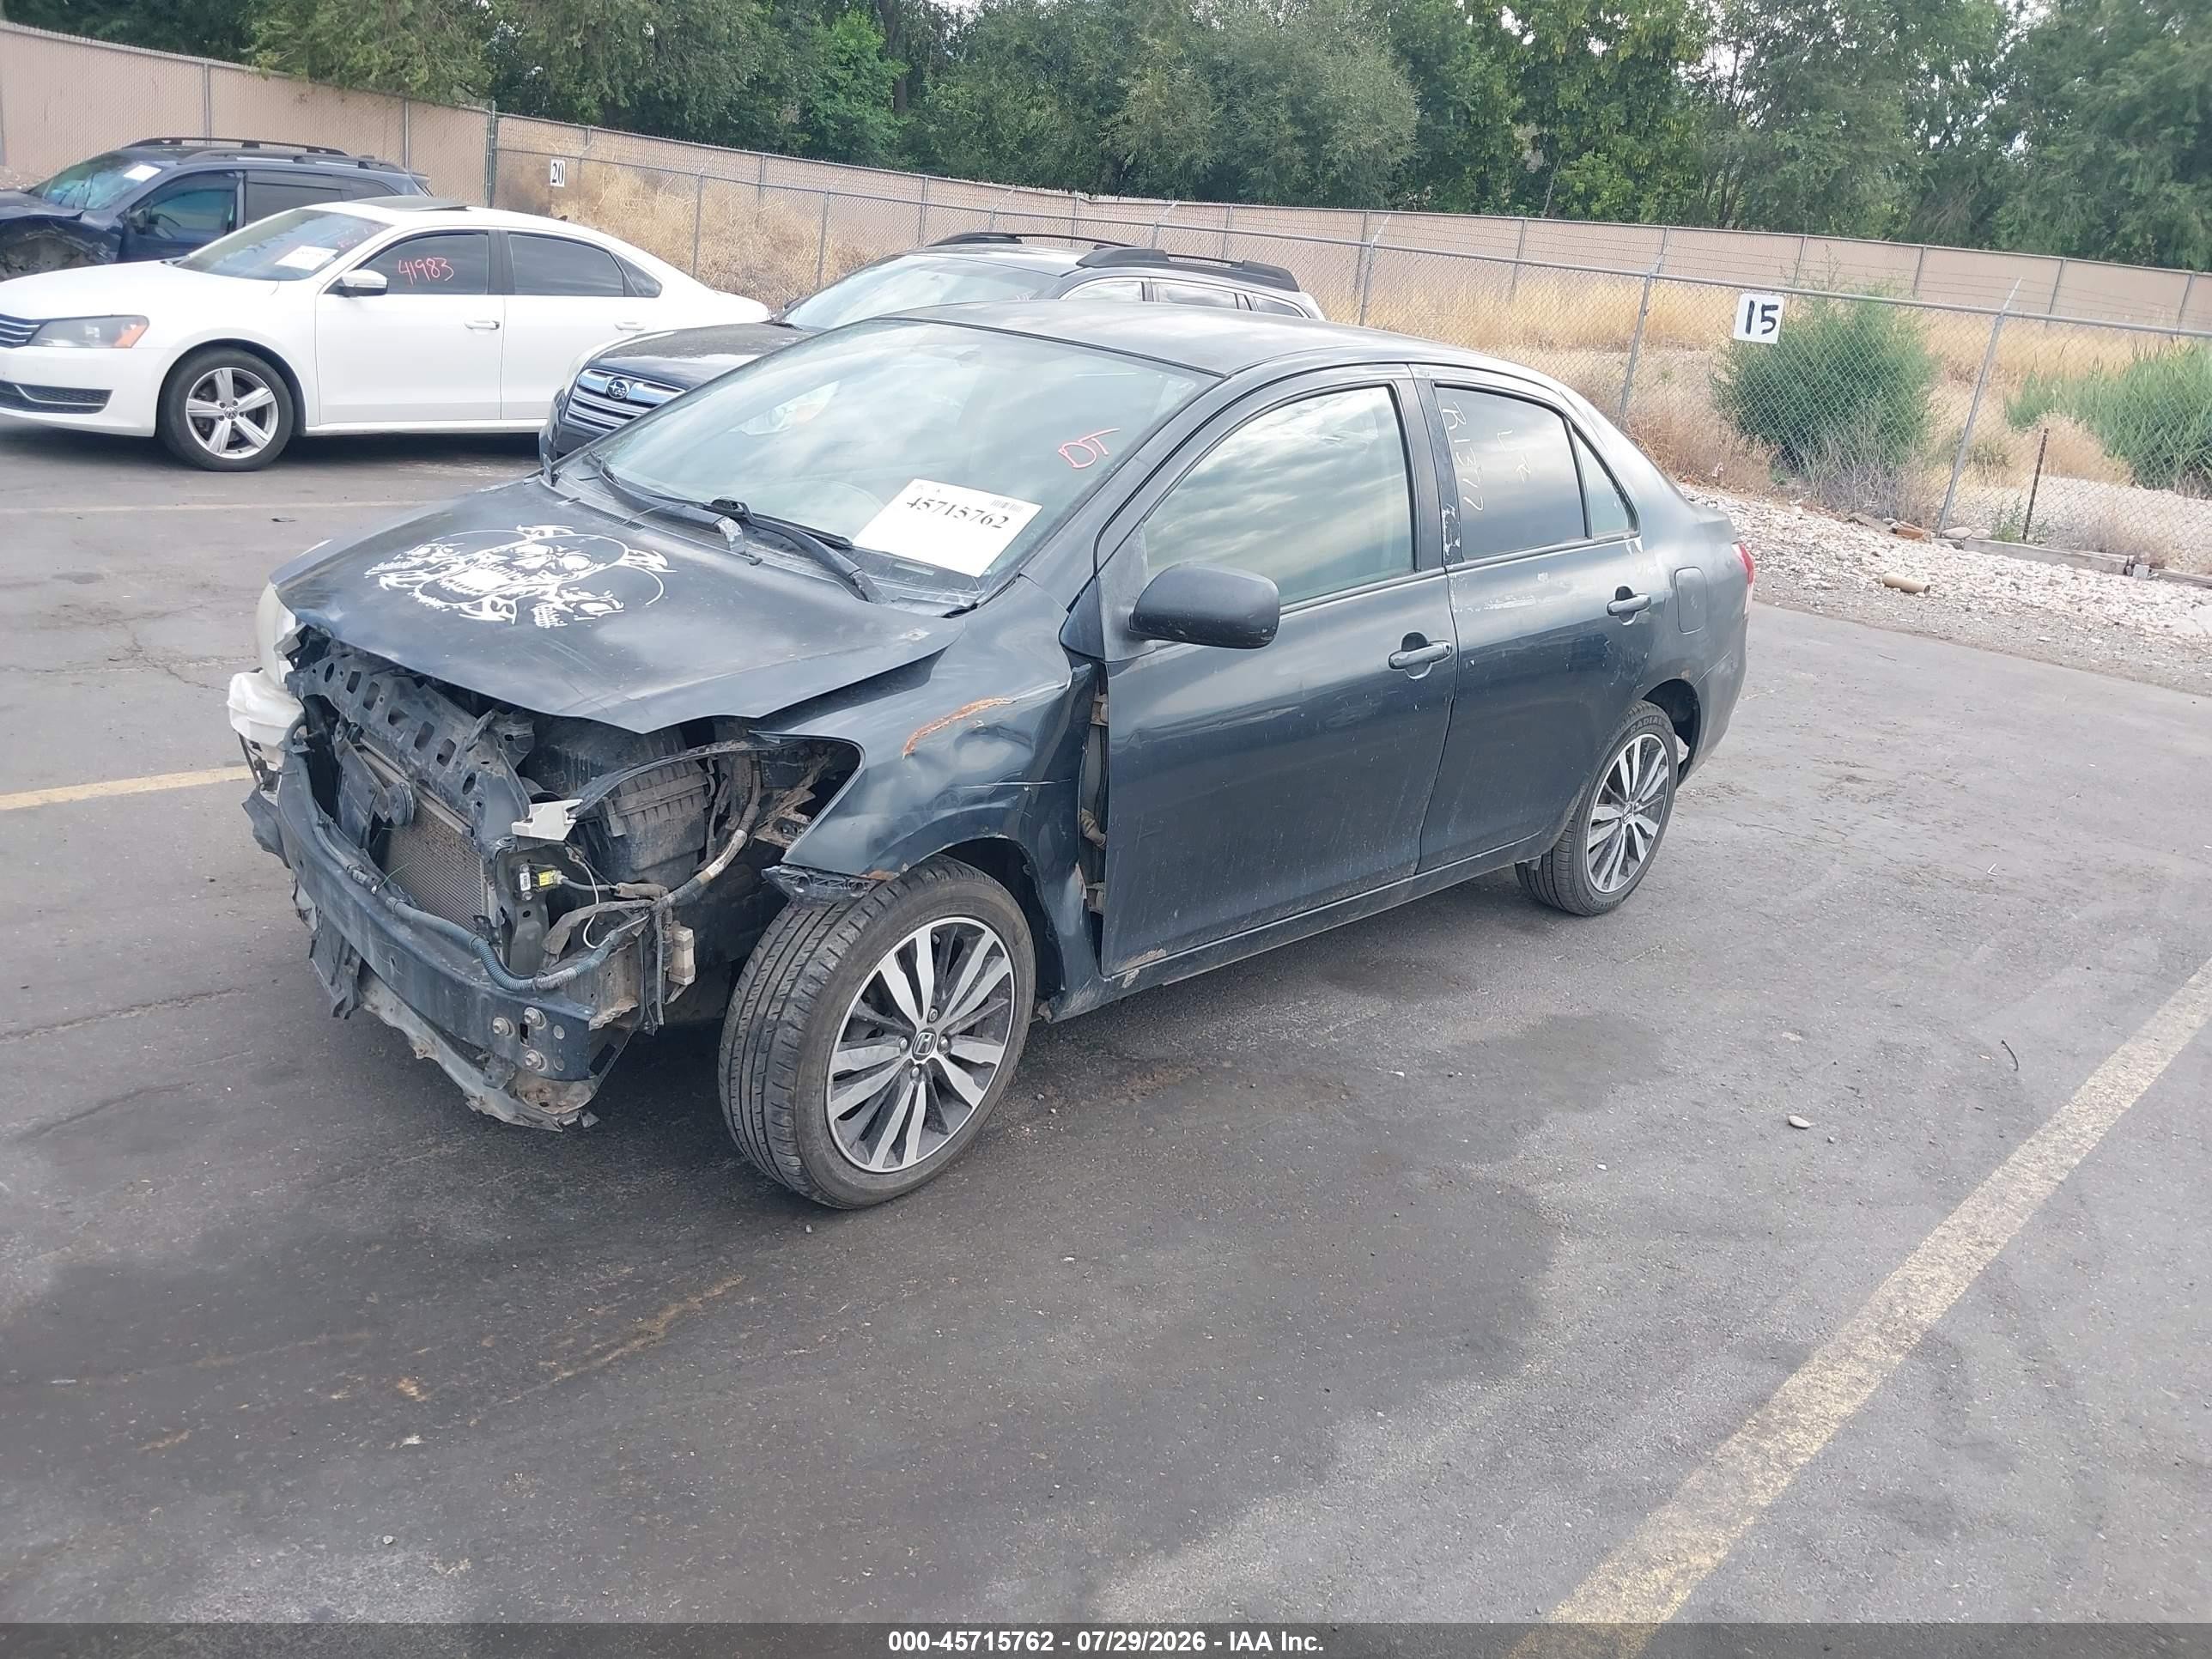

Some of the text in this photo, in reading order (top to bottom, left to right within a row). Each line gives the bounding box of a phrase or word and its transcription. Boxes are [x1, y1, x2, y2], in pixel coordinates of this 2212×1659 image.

[552, 162, 564, 185] 20
[398, 258, 454, 285] 41983
[1745, 301, 1779, 335] 15
[906, 496, 1010, 529] 45715762
[1630, 716, 1662, 735] RADIAL
